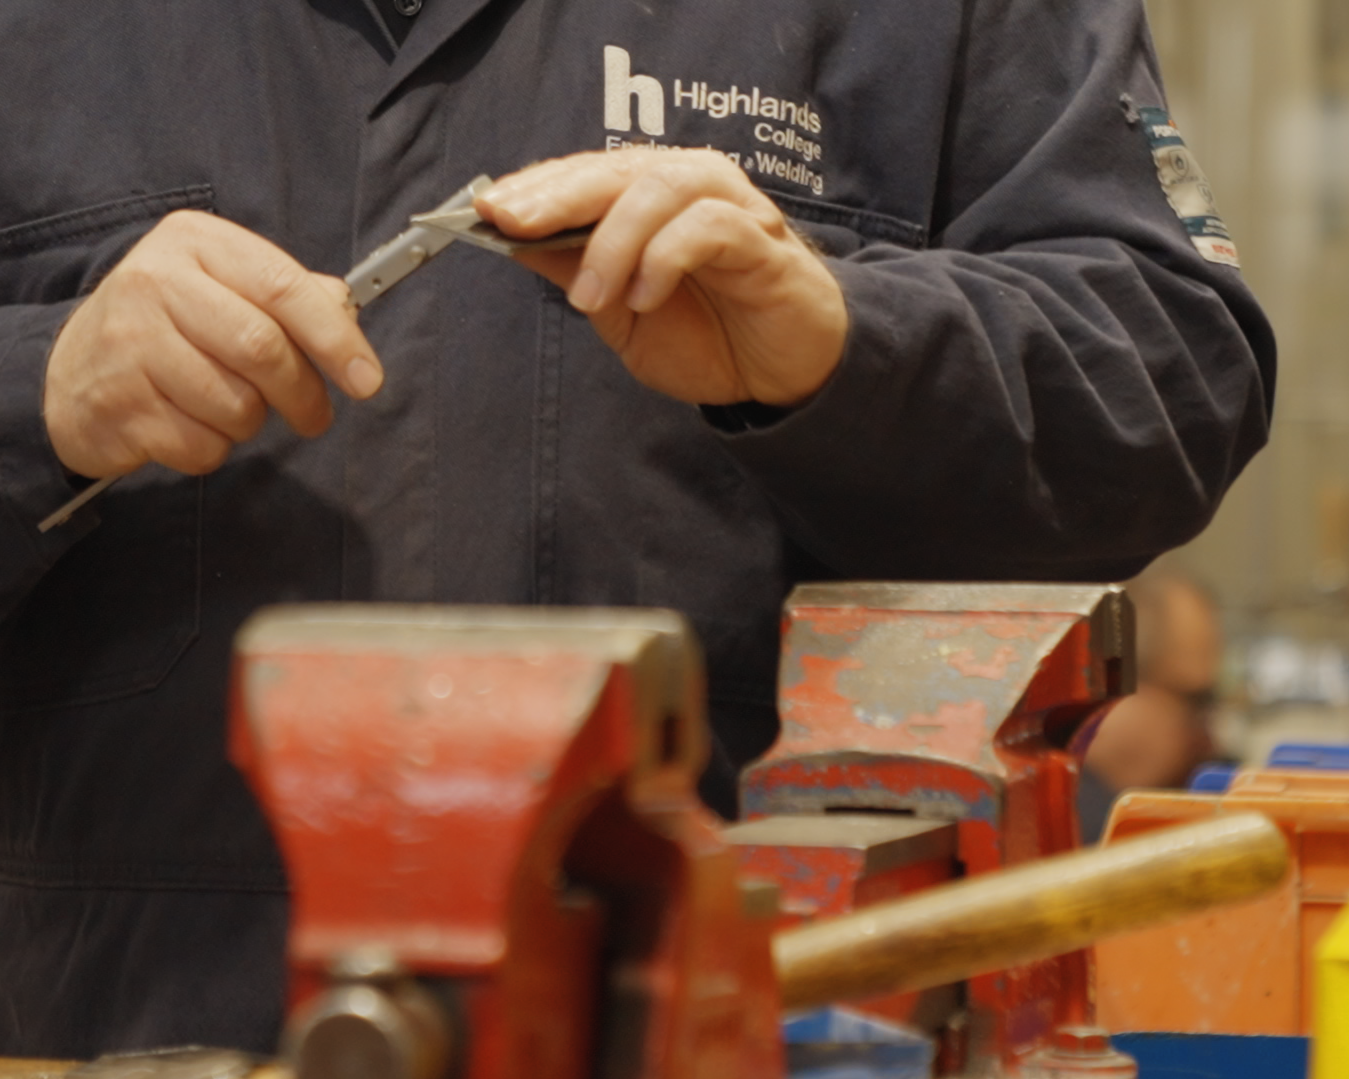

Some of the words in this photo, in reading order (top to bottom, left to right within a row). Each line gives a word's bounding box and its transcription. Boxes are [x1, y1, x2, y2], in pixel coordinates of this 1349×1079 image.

[604, 44, 664, 136] h
[674, 78, 822, 134] Highlands
[754, 122, 822, 162] College
[755, 150, 823, 195] Welding
